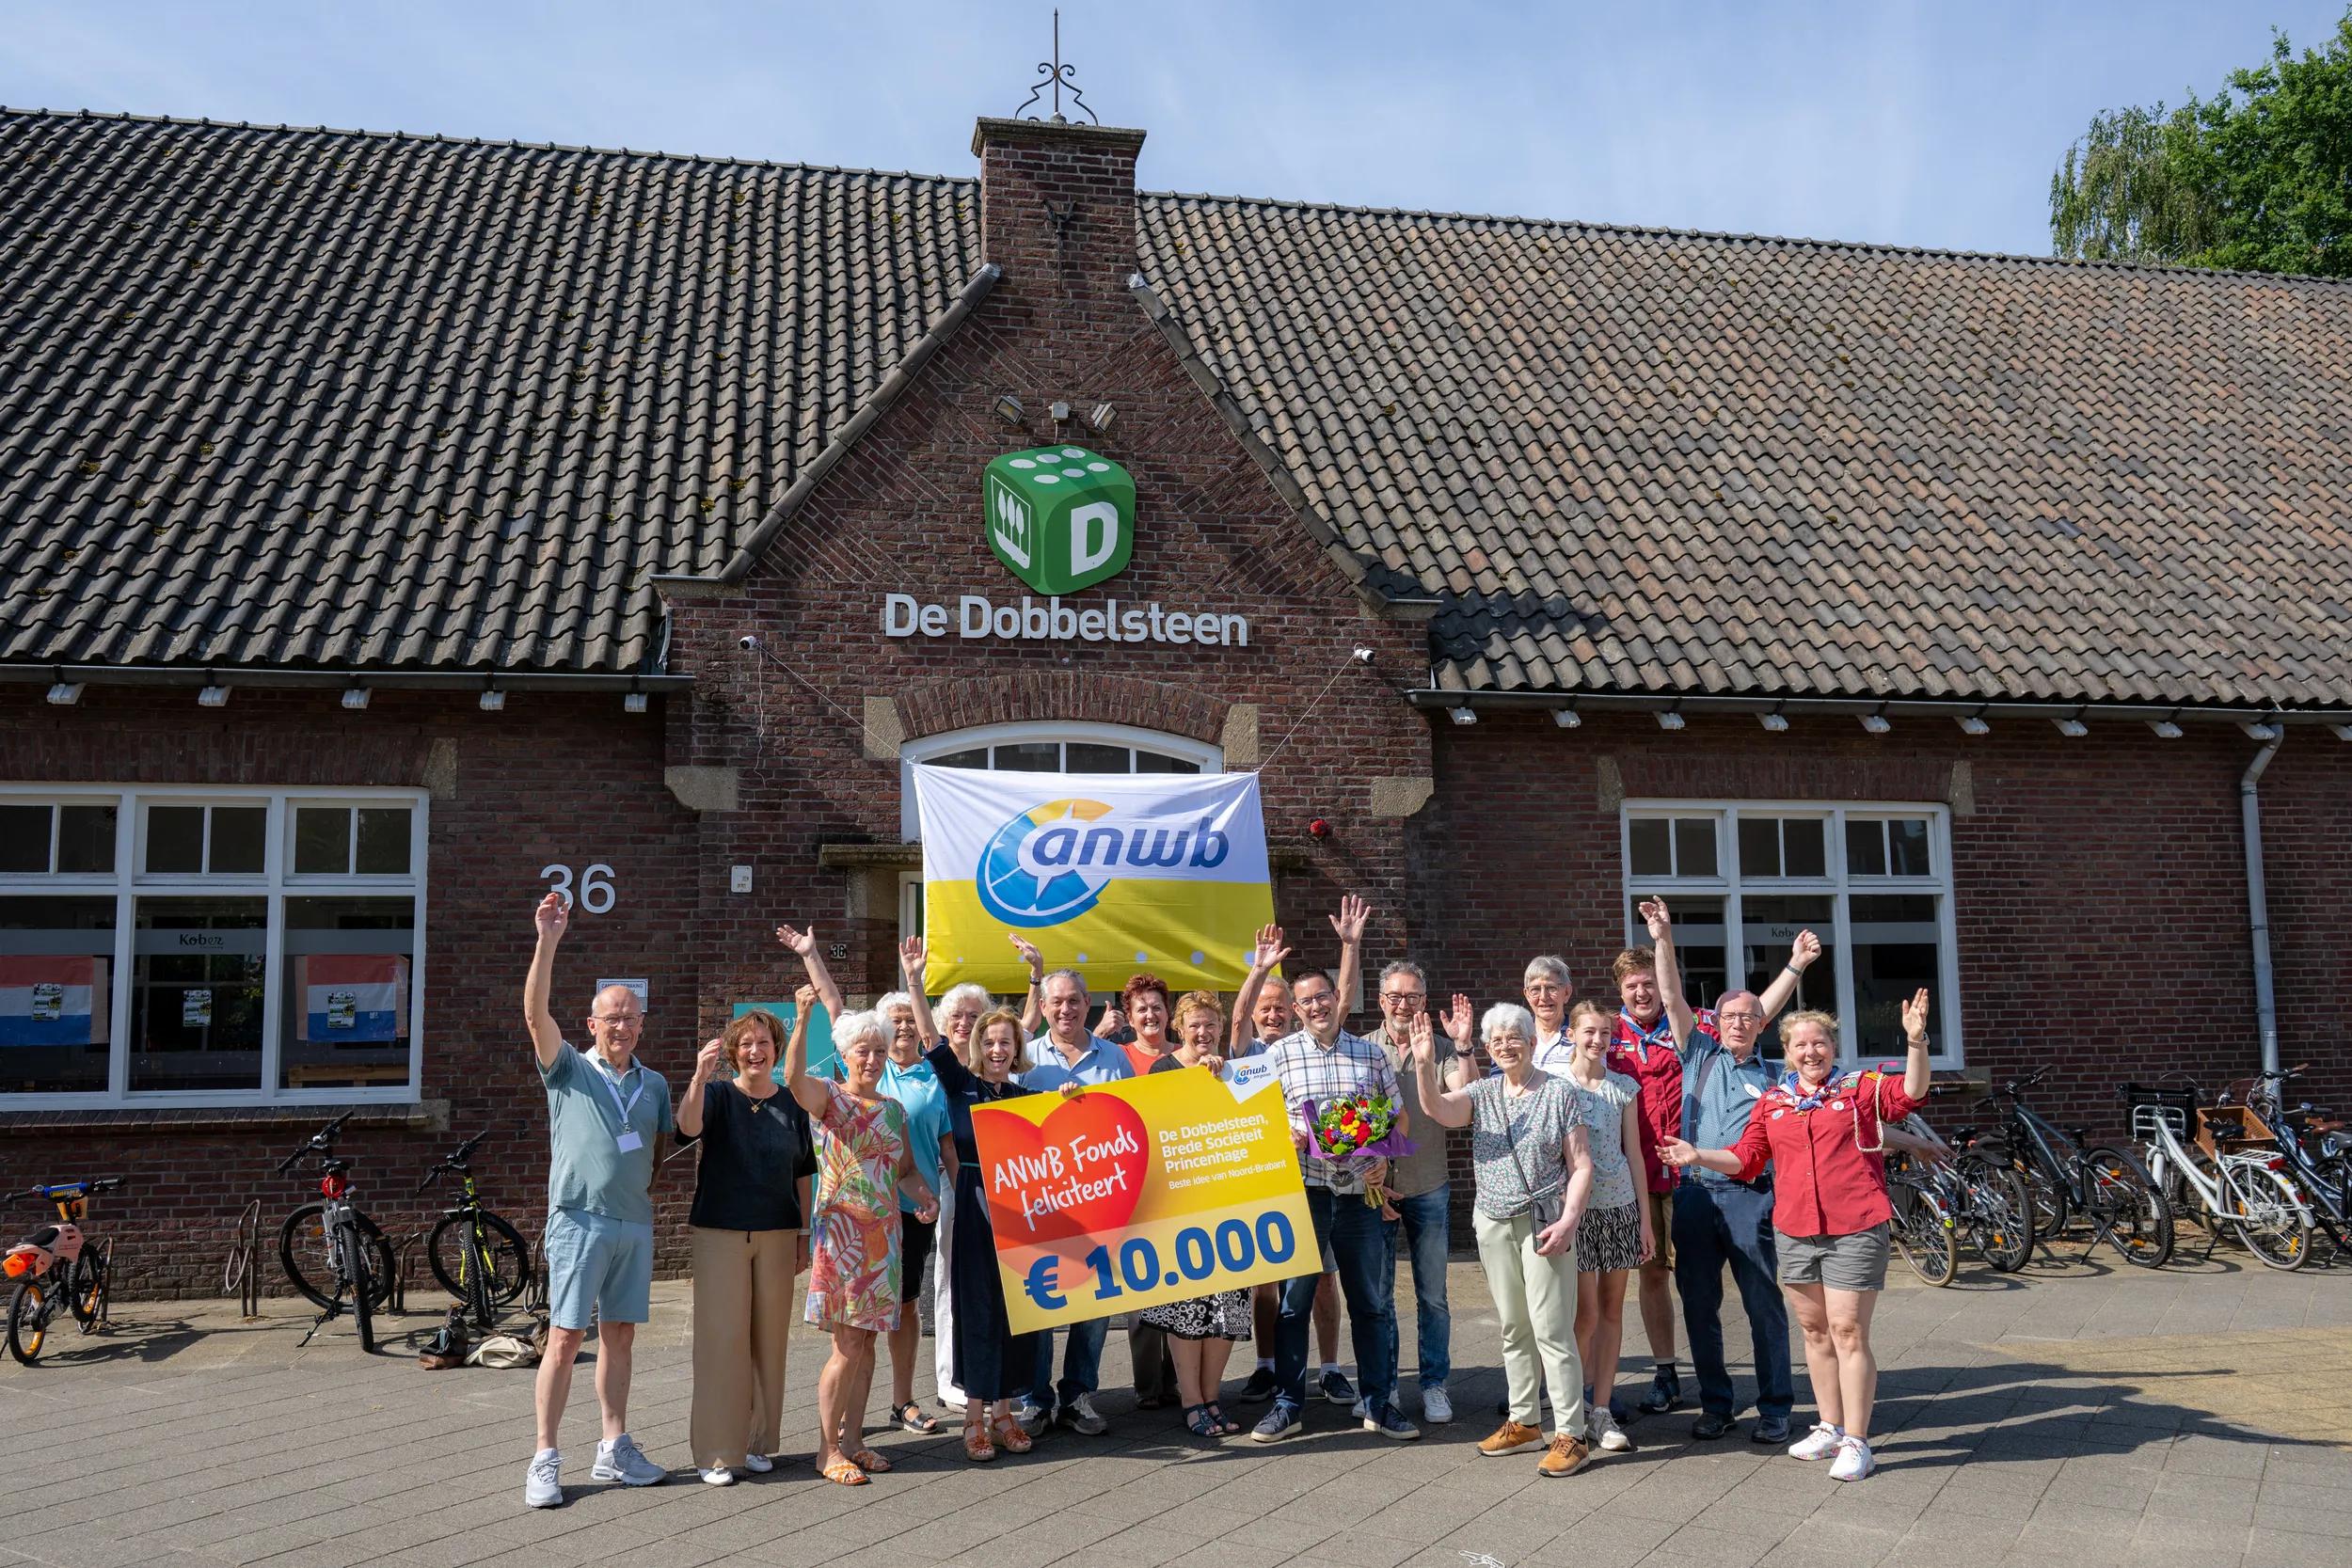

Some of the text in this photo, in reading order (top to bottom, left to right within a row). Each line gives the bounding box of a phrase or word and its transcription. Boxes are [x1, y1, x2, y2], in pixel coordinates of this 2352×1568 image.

[1071, 501, 1118, 577] D
[885, 594, 1248, 646] De Dobbelsteen
[1032, 816, 1230, 868] anwb
[540, 863, 616, 914] 36
[833, 944, 846, 958] 36
[1240, 1065, 1267, 1076] anwb
[1159, 1114, 1268, 1143] De Dobbelsteen,
[1162, 1128, 1264, 1158] Brede Sociëteit
[994, 1124, 1138, 1194] ANWB Fonds
[1165, 1148, 1248, 1173] Princenhage
[1168, 1160, 1287, 1190] Beste idee van Noord-Brabant
[1021, 1162, 1127, 1231] feliciteert
[1023, 1211, 1295, 1310] € 10.000
